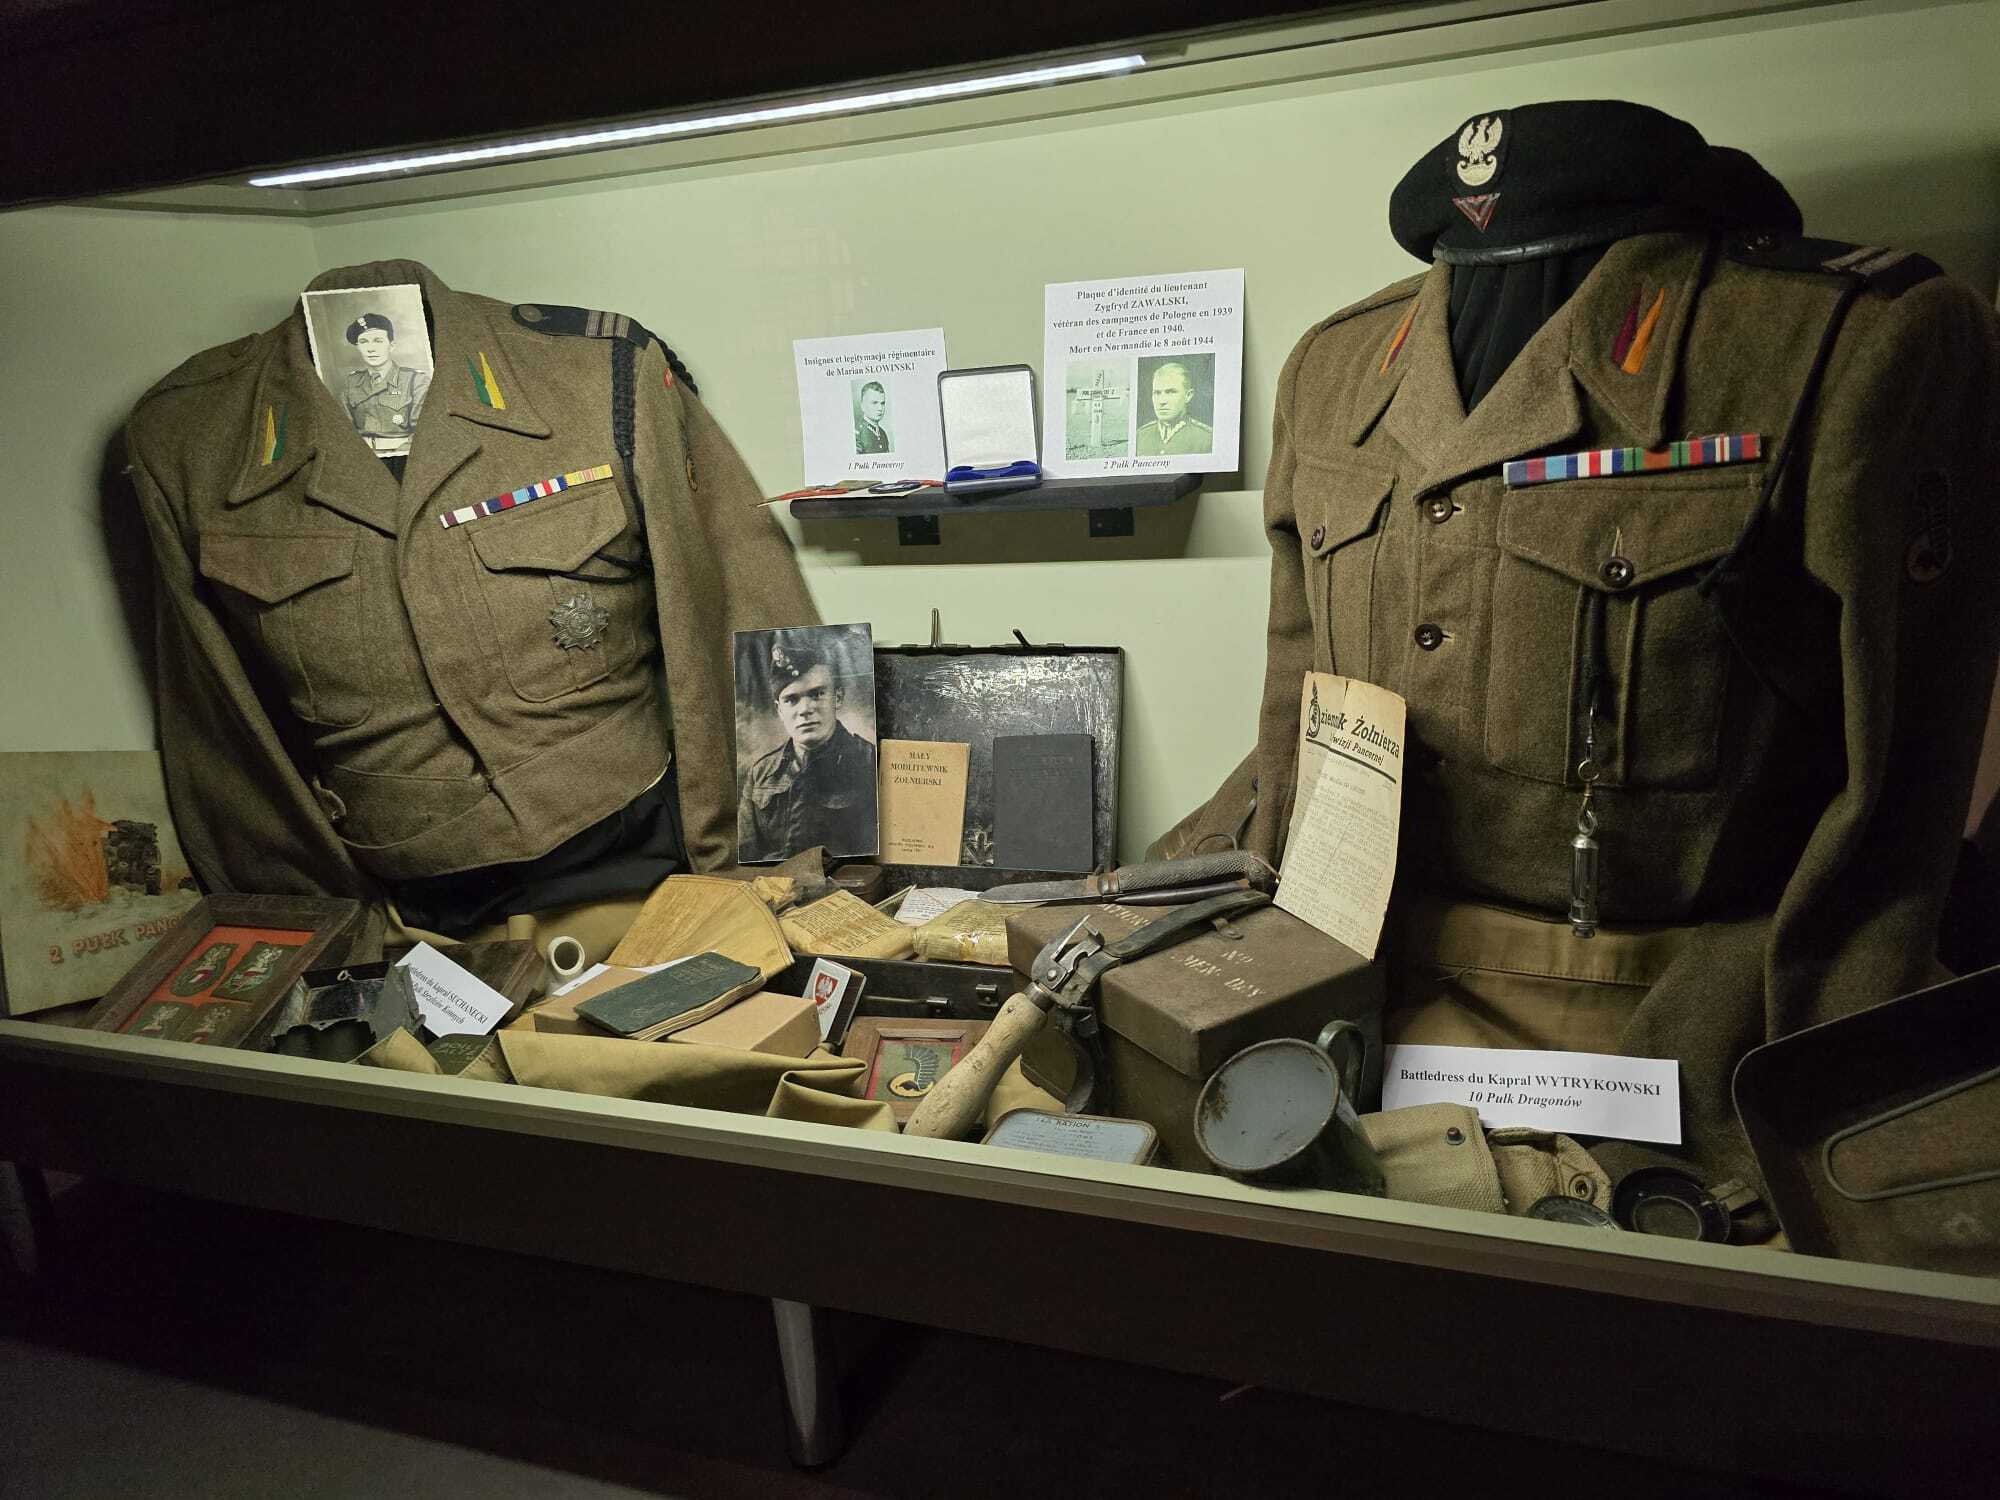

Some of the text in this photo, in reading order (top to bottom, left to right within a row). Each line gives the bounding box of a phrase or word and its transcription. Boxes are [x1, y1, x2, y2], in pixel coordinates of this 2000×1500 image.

[1077, 290, 1106, 301] Plaque
[1150, 285, 1162, 294] du
[1164, 282, 1208, 293] lieutenant
[1094, 299, 1129, 313] Zygfryd
[1053, 307, 1233, 329] vétéran des campagnes de Pologne en 1939
[1096, 331, 1105, 339] et
[1106, 329, 1117, 338] de
[1118, 326, 1148, 337] France
[1149, 327, 1160, 335] en
[1069, 335, 1214, 354] Mort en Normandie le 8 août 1944
[804, 357, 834, 367] Insignes
[835, 356, 842, 364] et
[826, 369, 835, 377] de
[837, 367, 864, 376] Marian
[1104, 461, 1109, 469] 2
[1132, 459, 1170, 470] Pancerny
[1401, 1069, 1662, 1096] Battledress du Kapral WYTRYKOWSKI
[1468, 1091, 1483, 1102] 10
[1517, 1094, 1583, 1108] Dragonów
